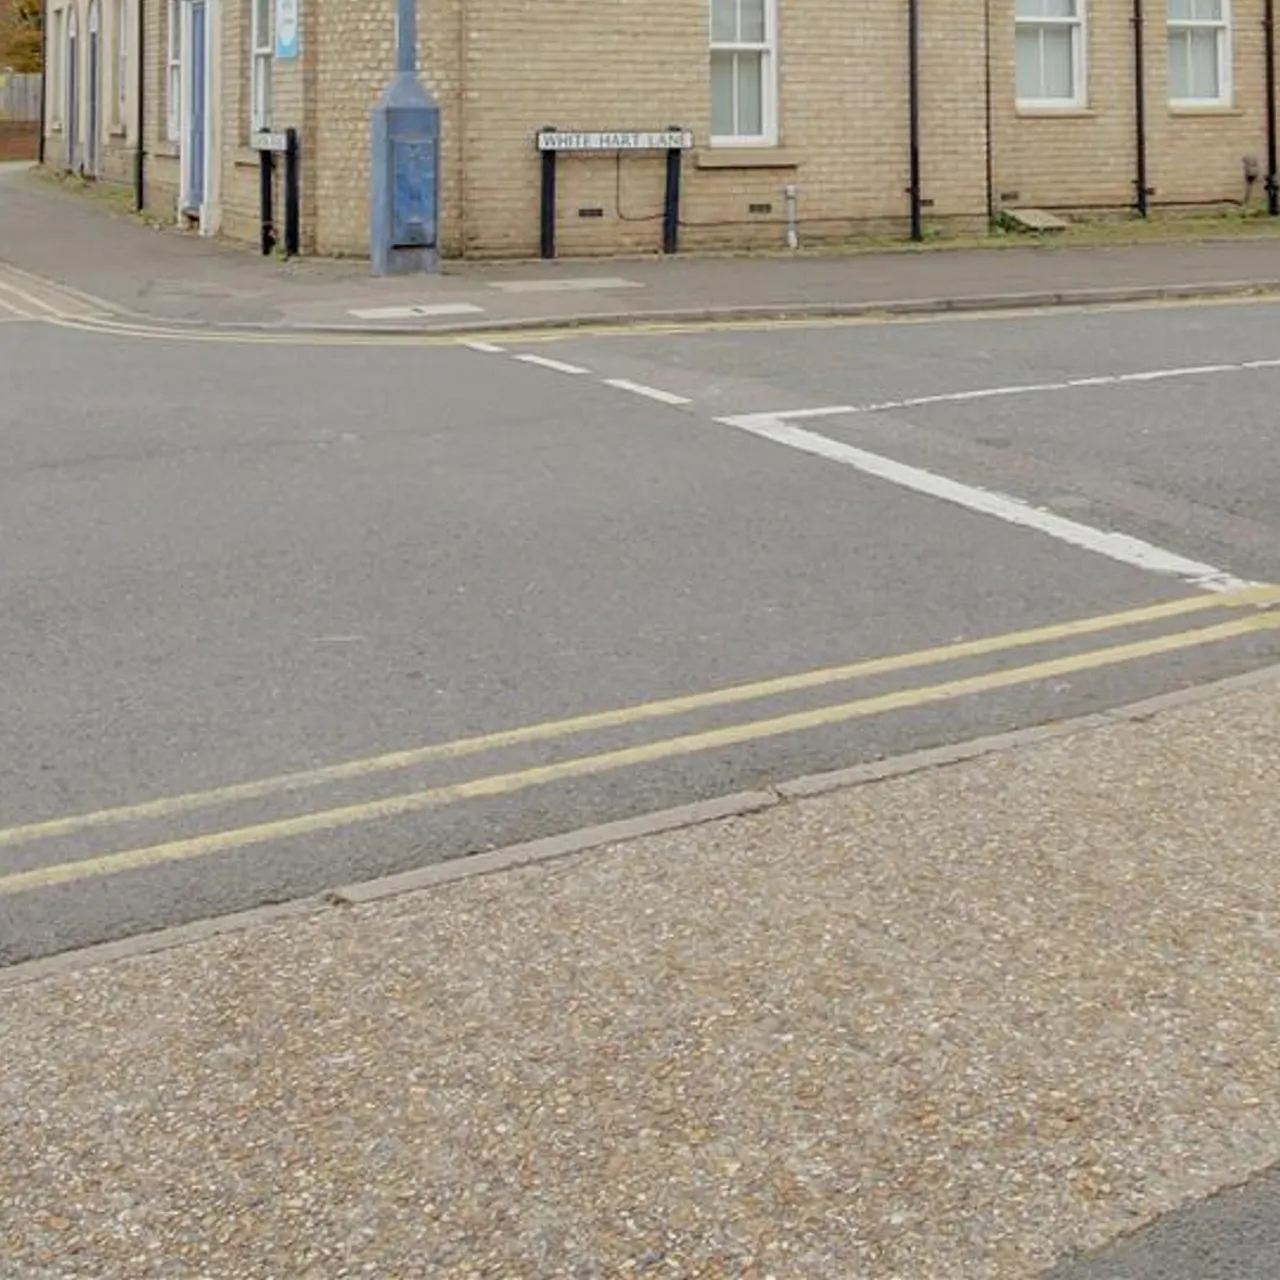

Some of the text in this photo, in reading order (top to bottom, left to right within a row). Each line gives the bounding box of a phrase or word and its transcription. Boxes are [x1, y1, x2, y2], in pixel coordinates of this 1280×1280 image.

[543, 133, 686, 147] WHITE HART LANE
